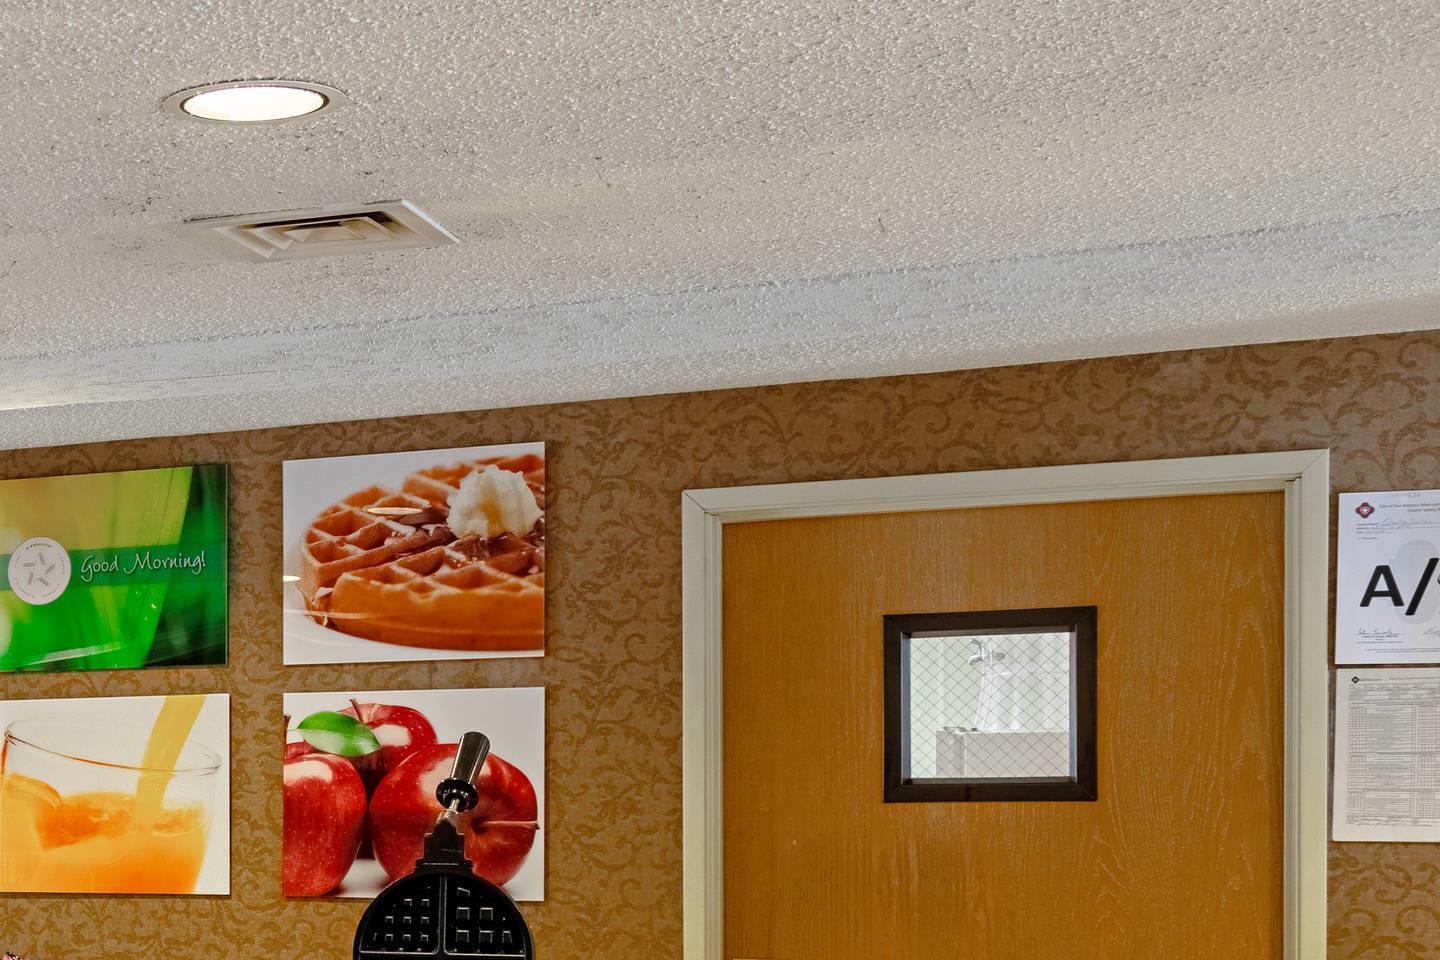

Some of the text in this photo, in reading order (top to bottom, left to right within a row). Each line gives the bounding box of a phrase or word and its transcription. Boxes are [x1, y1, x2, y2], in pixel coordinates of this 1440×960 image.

[80, 554, 120, 583] Good
[123, 550, 207, 576] Morning!
[1359, 557, 1440, 616] A/
